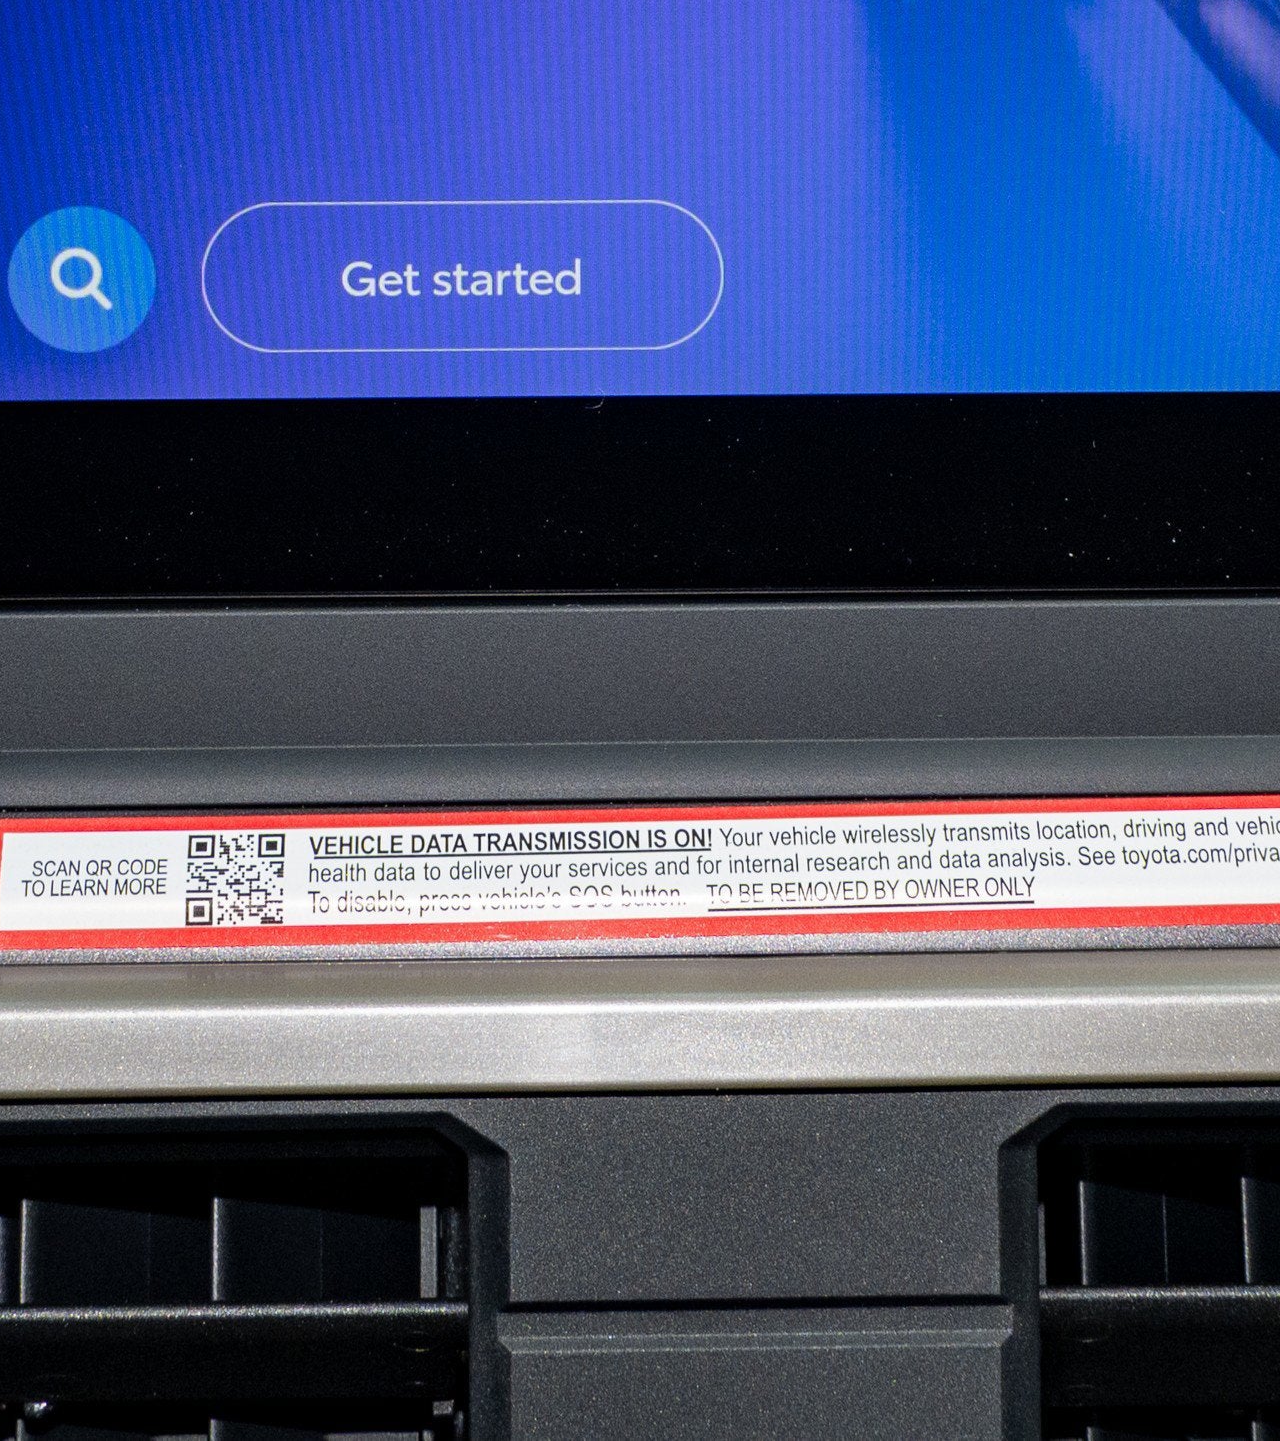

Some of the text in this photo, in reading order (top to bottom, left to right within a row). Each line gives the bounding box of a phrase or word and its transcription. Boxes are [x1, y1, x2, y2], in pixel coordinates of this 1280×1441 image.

[340, 258, 582, 298] Get started
[309, 835, 403, 855] VEHICLE
[410, 833, 468, 853] DATA
[472, 829, 641, 852] TRANSMISSION
[647, 829, 668, 848] IS
[674, 828, 713, 848] ON!
[720, 828, 764, 847] Your
[768, 825, 837, 846] vehicle
[842, 823, 937, 848] wirelessly
[943, 821, 1031, 842] transmits
[1036, 820, 1118, 842] location,
[1123, 818, 1187, 842] driving
[1193, 816, 1230, 837] and
[32, 859, 169, 877] SCAN QR CODE
[308, 862, 368, 883] health
[373, 862, 416, 882] data
[423, 862, 442, 881] to
[448, 860, 514, 880] deliver
[519, 862, 563, 885] your
[568, 857, 648, 878] services
[654, 855, 691, 876] and
[696, 854, 724, 875] for
[728, 854, 800, 874] internal
[805, 851, 890, 873] research
[896, 849, 934, 871] and
[939, 849, 982, 869] data
[987, 846, 1072, 873] analysis.
[1077, 845, 1117, 867] See
[21, 878, 168, 898] TO LEARN MORE
[307, 890, 331, 914] To
[337, 889, 412, 916] disable,
[419, 893, 472, 917] press
[739, 883, 764, 904] BE
[770, 880, 869, 902] REMOVED
[874, 879, 900, 900] BY
[904, 878, 980, 899] OWNER
[987, 876, 1036, 897] ONLY
